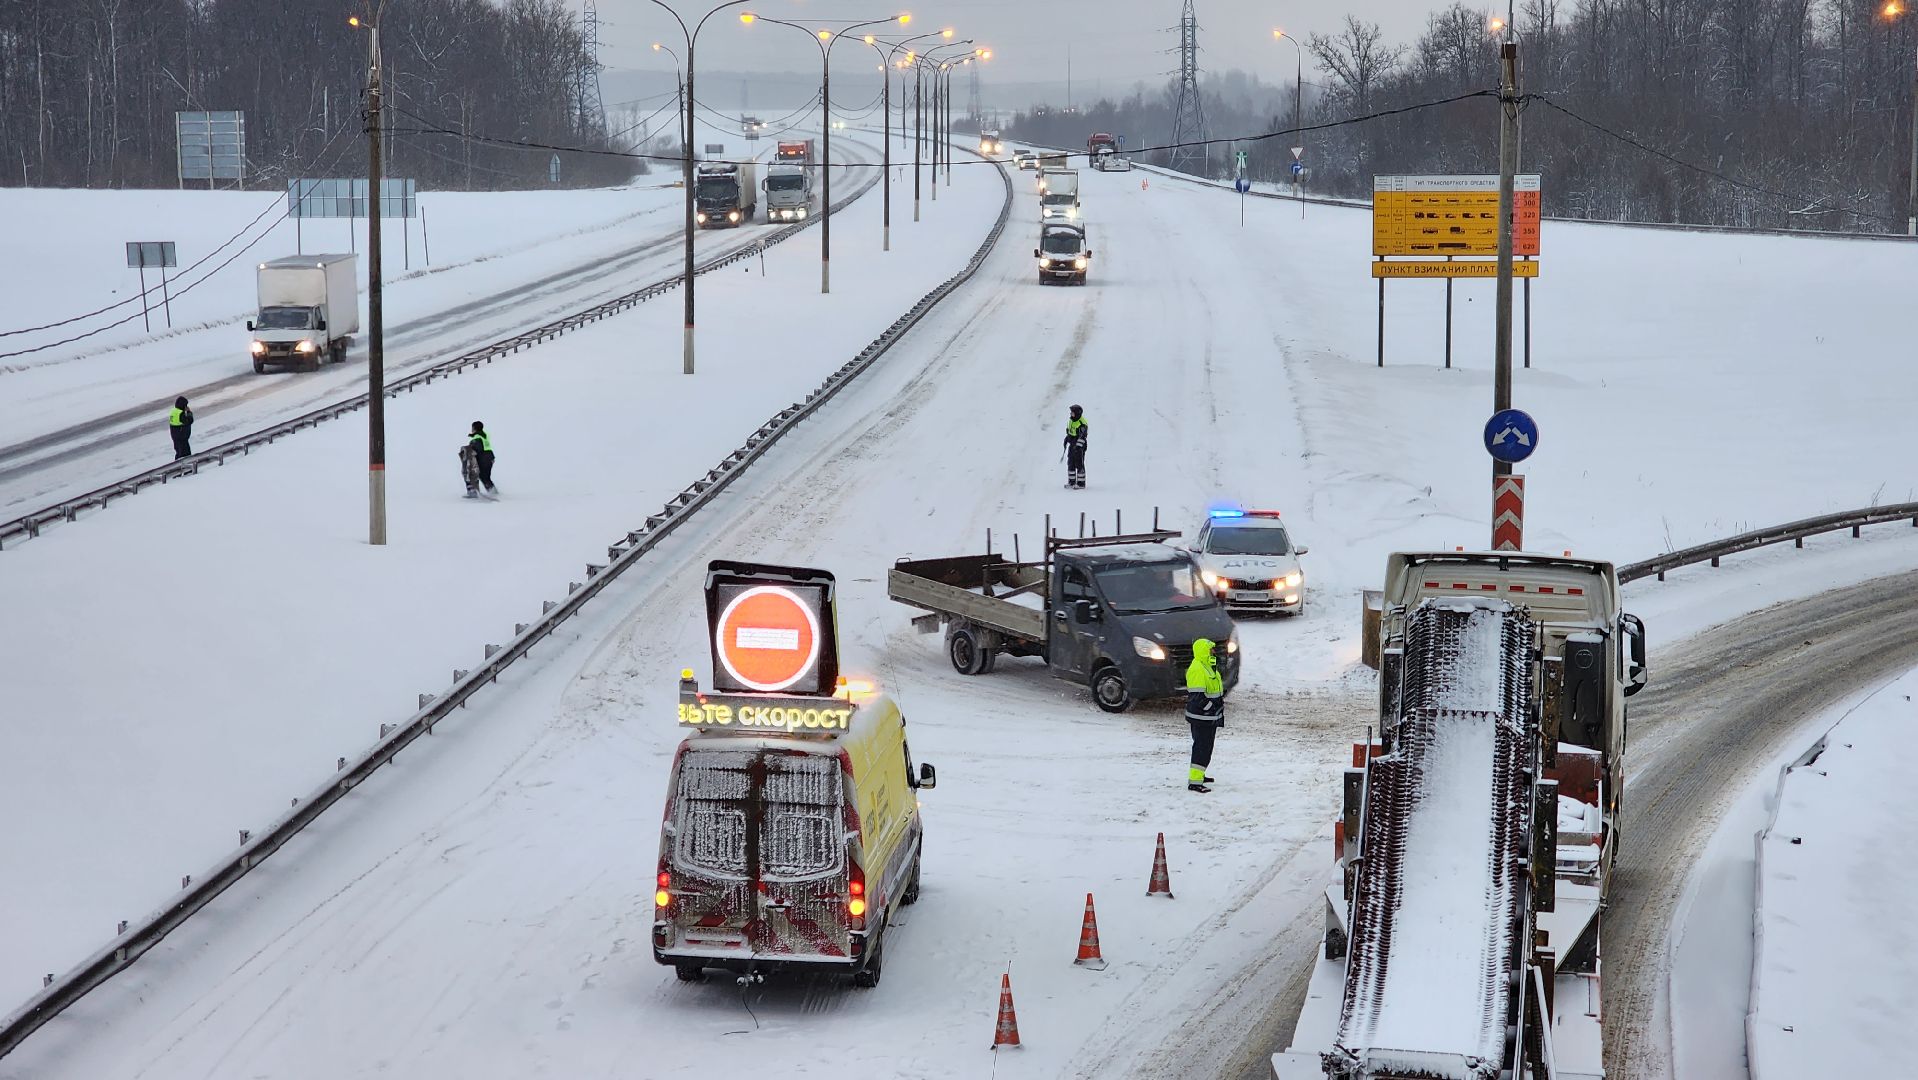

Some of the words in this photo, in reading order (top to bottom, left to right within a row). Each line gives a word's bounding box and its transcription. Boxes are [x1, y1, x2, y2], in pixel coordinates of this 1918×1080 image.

[1380, 265, 1411, 274] ПУНКТ
[1414, 265, 1467, 274] ВЗИМАНИЯ
[1470, 265, 1496, 273] ПЛАТ
[1521, 265, 1530, 273] 71
[1223, 559, 1277, 569] ДПС
[738, 705, 851, 732] скорост
